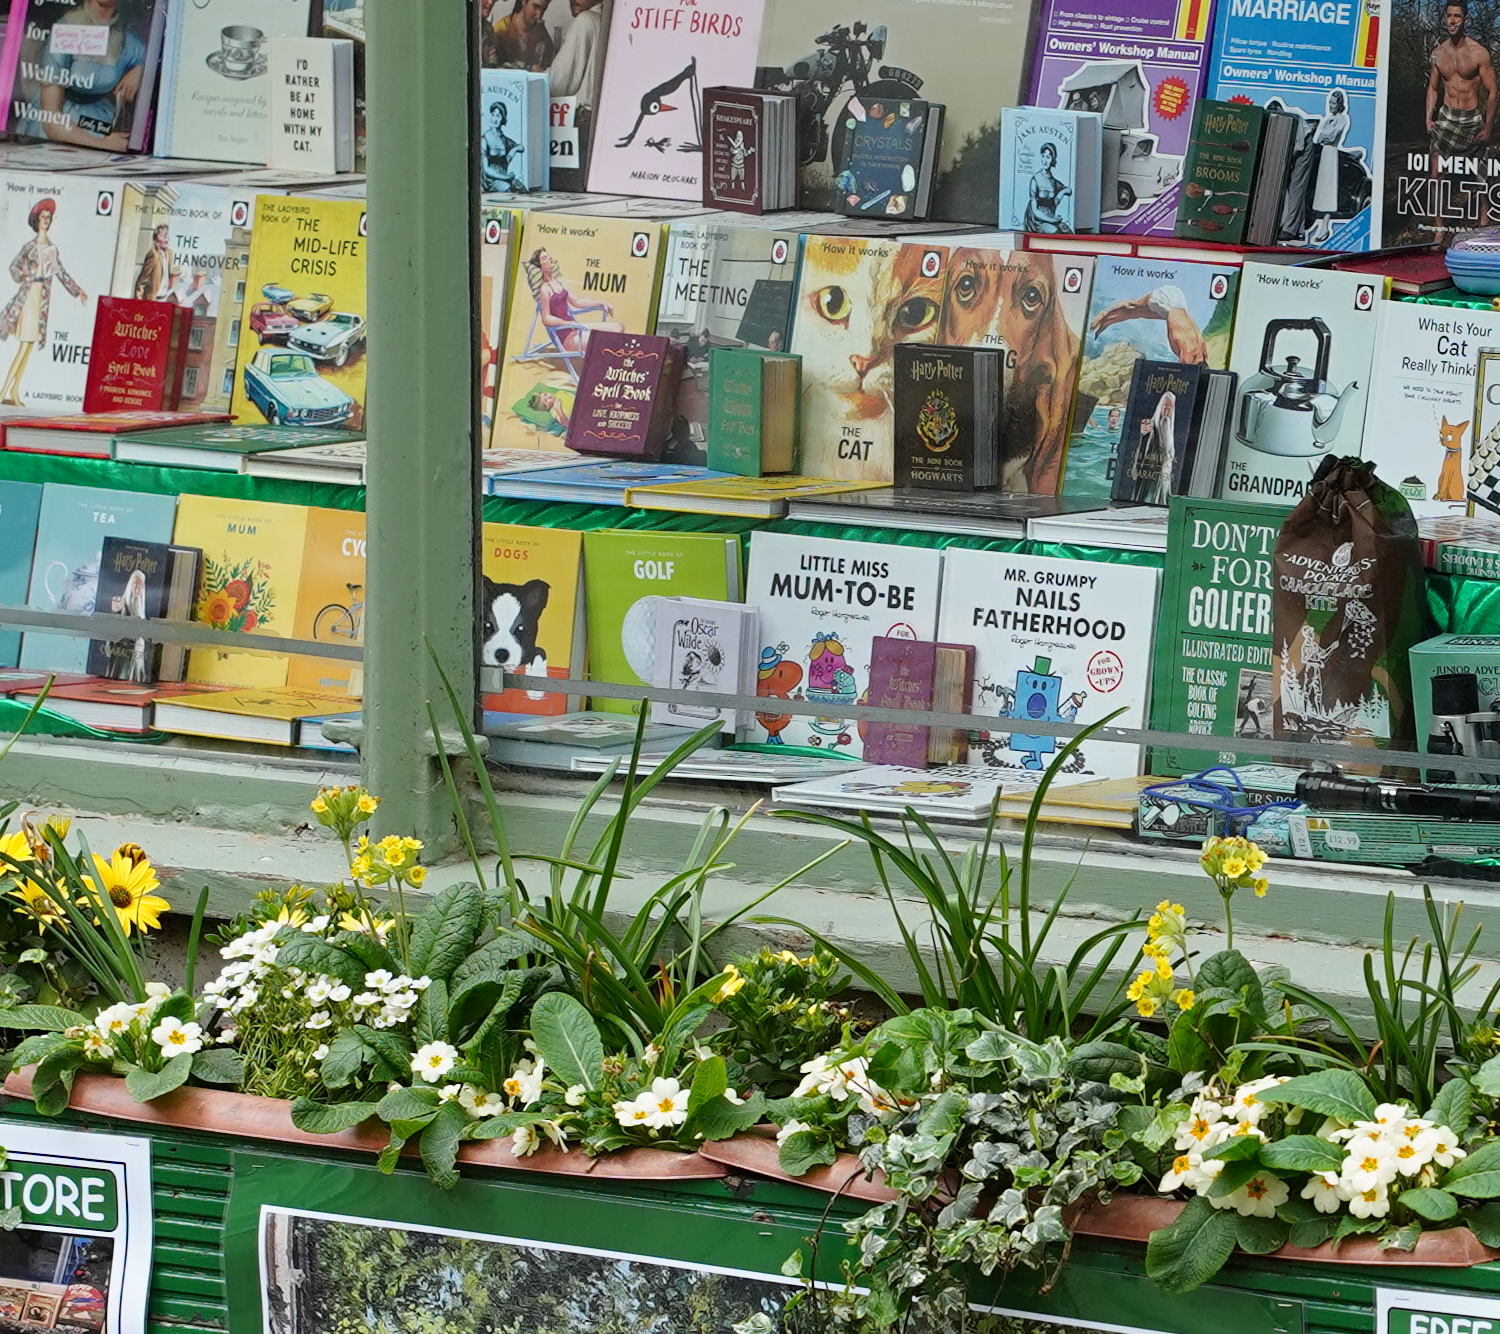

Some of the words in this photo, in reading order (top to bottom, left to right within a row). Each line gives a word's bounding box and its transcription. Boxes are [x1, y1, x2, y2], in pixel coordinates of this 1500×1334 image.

[631, 9, 684, 32] STIFF
[690, 13, 743, 37] BIRDS
[1231, 0, 1351, 27] MARRIAGE
[1406, 153, 1429, 172] 101
[1437, 154, 1479, 174] MEN
[800, 554, 848, 574] LITTLE
[851, 559, 889, 578] MISS
[770, 574, 915, 610] MUM-TO-BE
